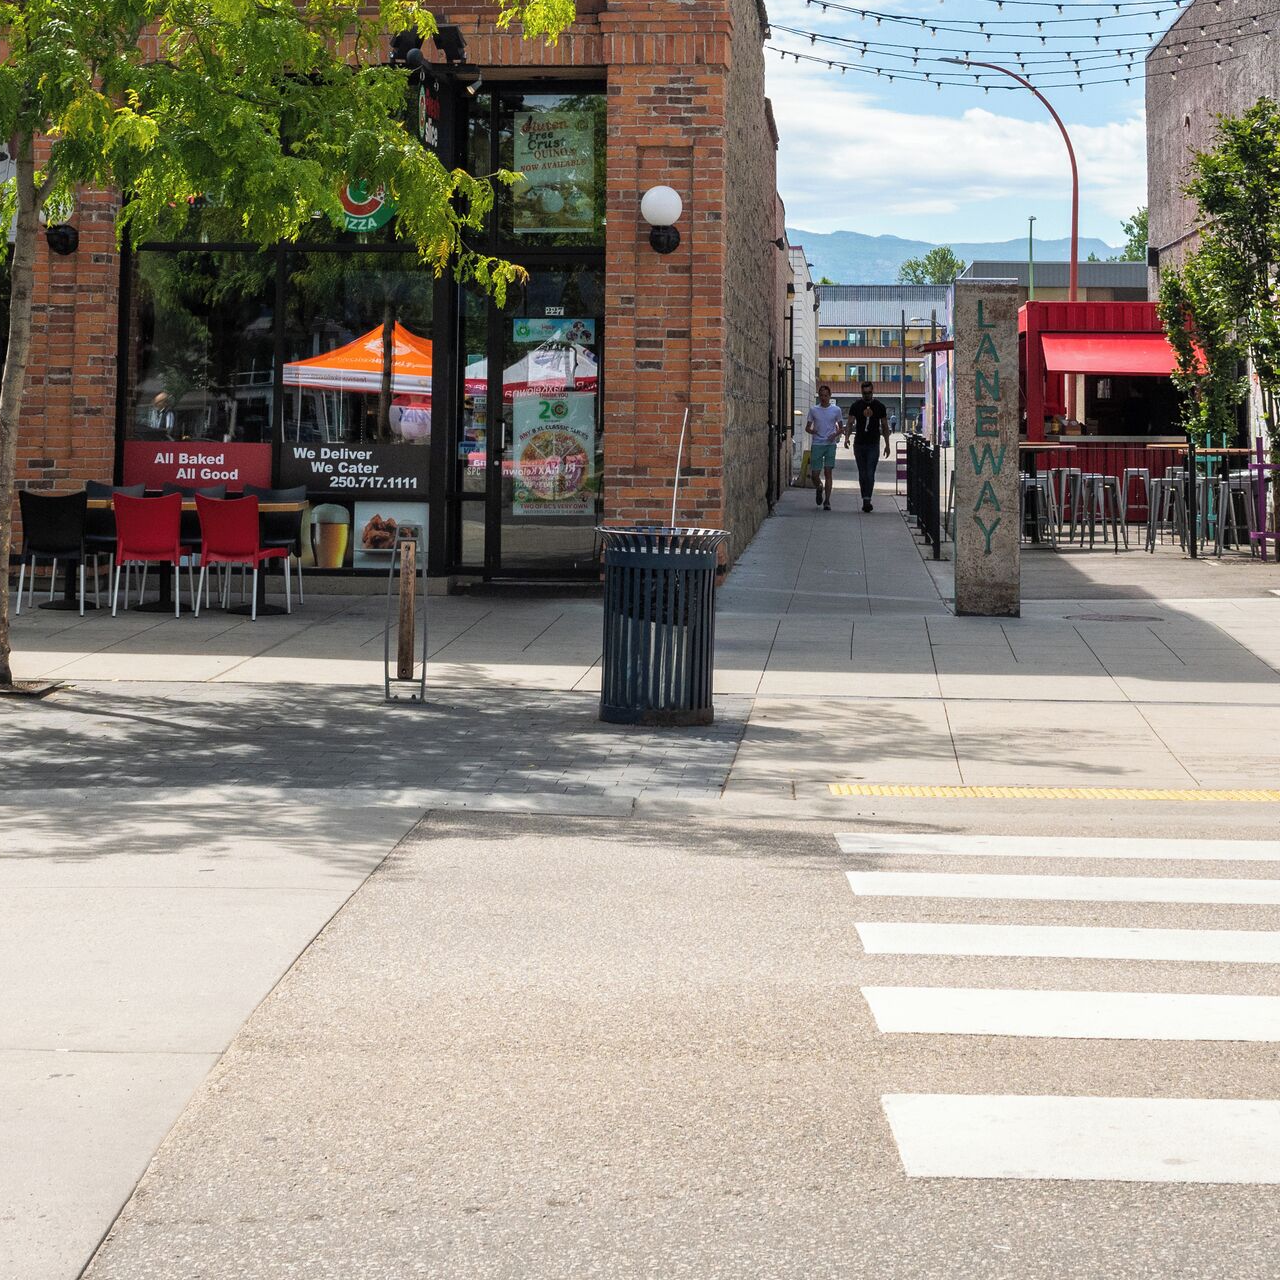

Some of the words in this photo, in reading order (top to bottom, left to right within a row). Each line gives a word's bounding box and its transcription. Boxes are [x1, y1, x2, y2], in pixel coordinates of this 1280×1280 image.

[528, 130, 554, 141] Free
[528, 137, 566, 150] Crust
[521, 163, 539, 172] NOW
[344, 217, 378, 230] IZZA
[970, 299, 1006, 555] LANEWAY
[154, 453, 174, 464] All
[178, 453, 224, 465] Baked
[293, 448, 316, 459] We
[320, 448, 372, 460] Deliver
[176, 468, 196, 479] All
[200, 468, 238, 480] Good
[311, 462, 334, 473] We
[338, 462, 379, 474] Cater
[329, 476, 418, 489] 250.717.1111
